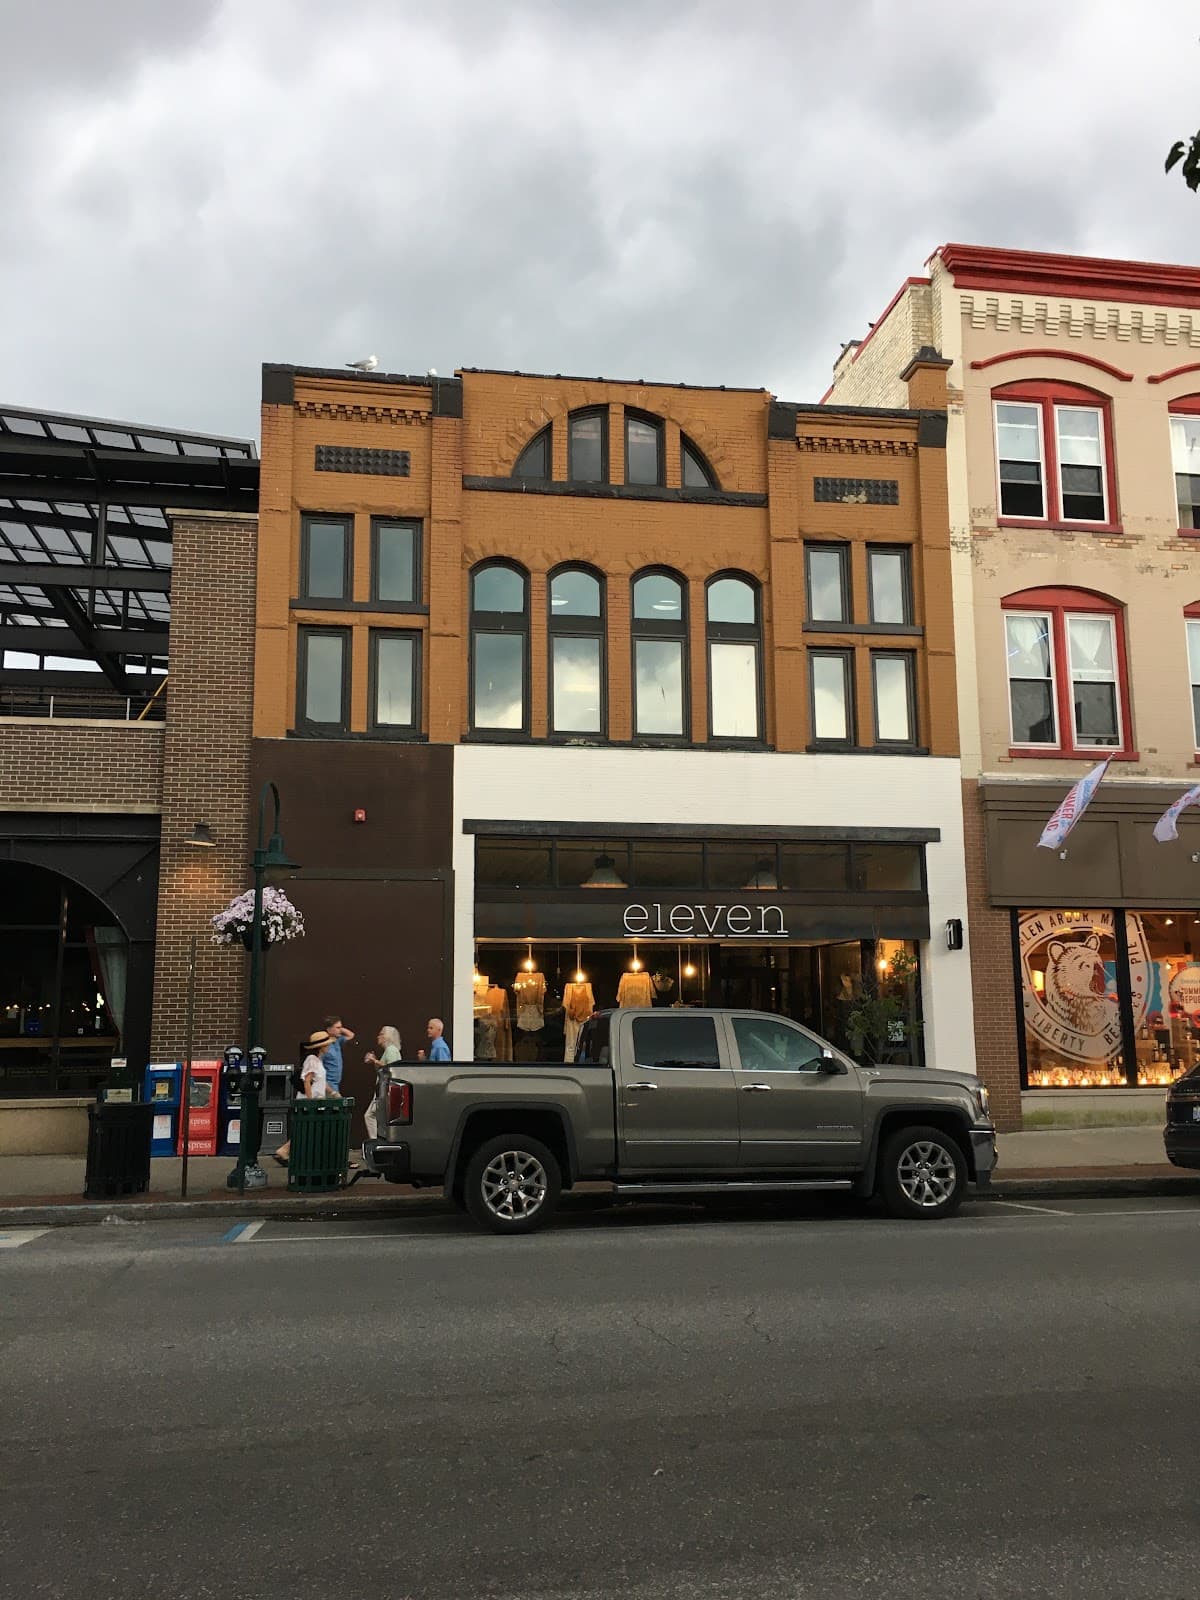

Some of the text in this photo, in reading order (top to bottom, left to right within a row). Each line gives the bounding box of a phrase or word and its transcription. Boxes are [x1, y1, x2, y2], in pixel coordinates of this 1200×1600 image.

[1061, 784, 1079, 819] MMER
[623, 903, 789, 934] eleven
[1032, 1012, 1086, 1051] LIBERTY
[188, 1118, 211, 1127] xpress
